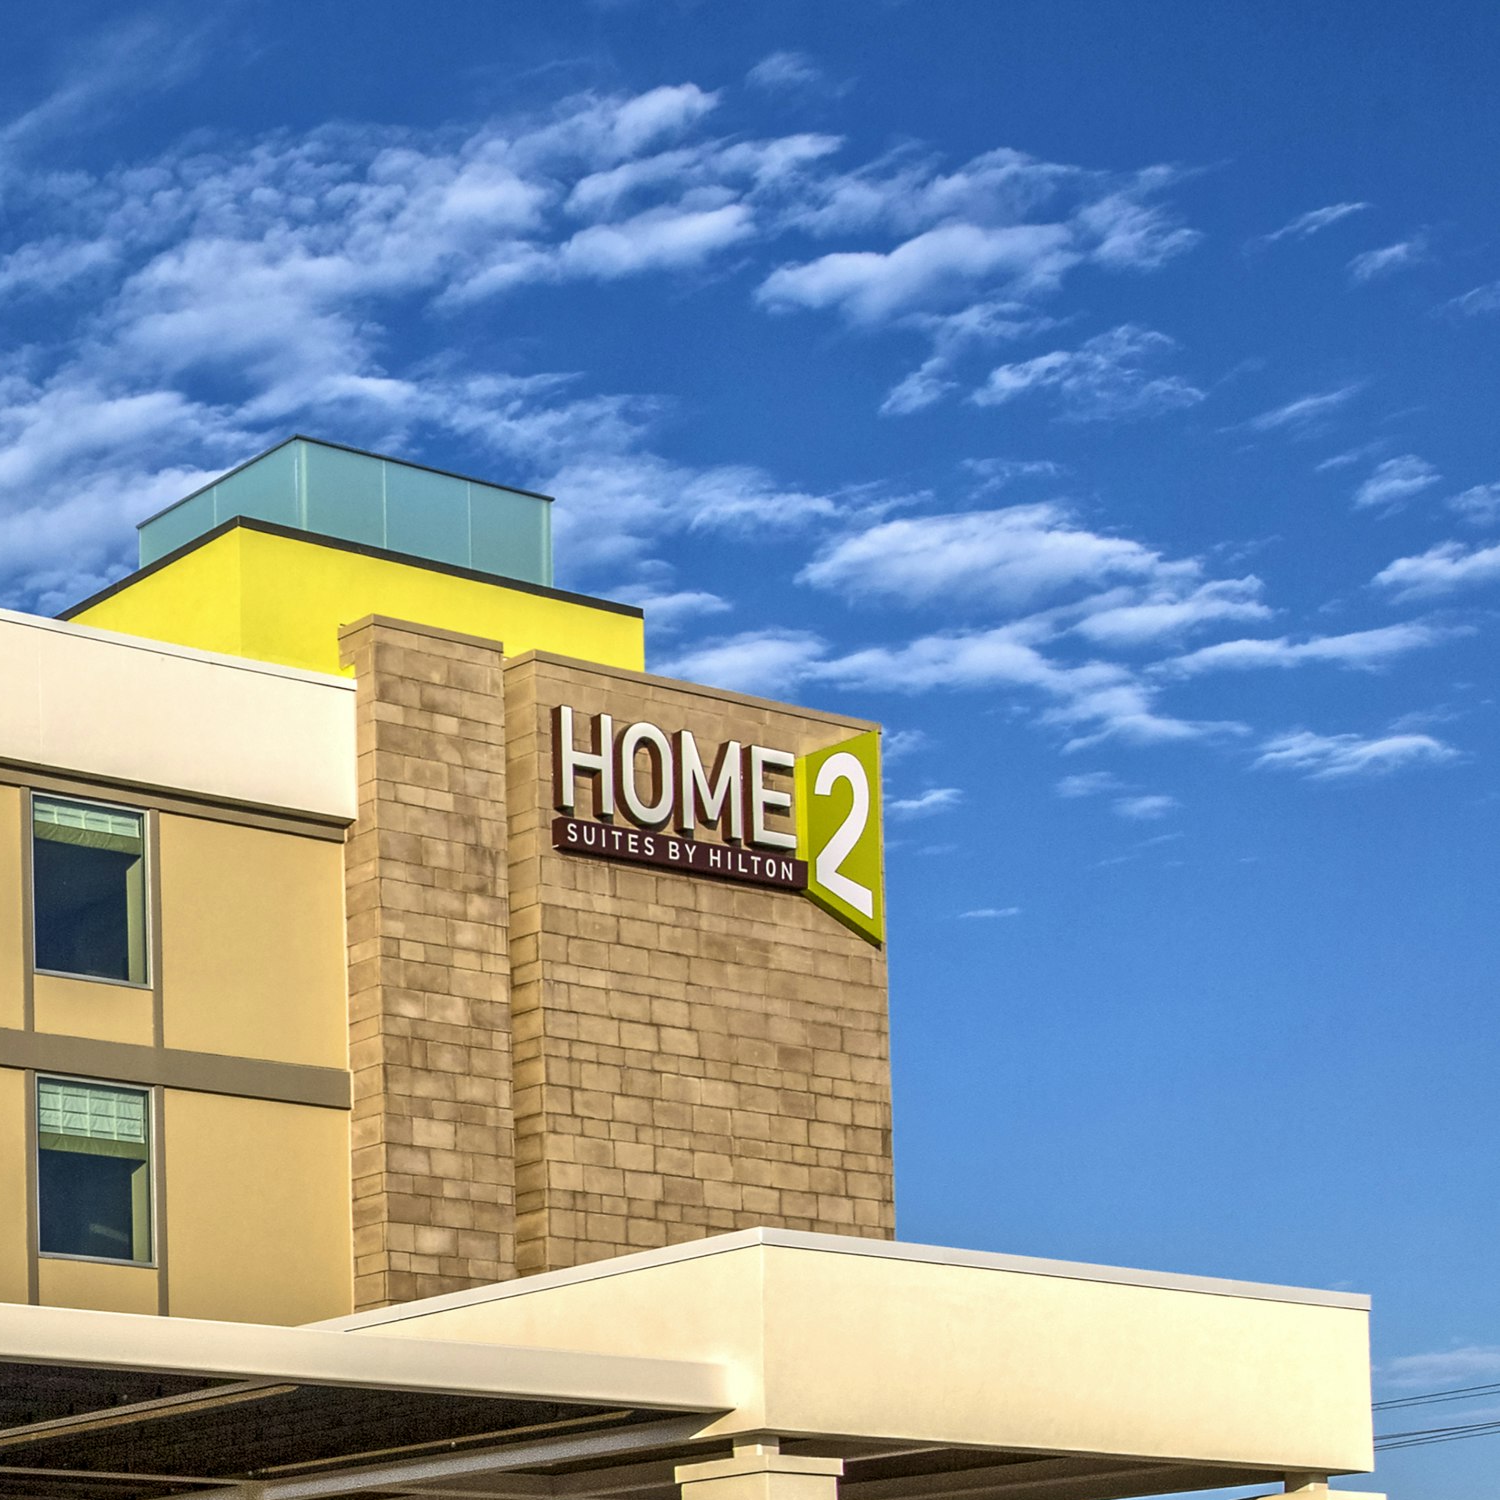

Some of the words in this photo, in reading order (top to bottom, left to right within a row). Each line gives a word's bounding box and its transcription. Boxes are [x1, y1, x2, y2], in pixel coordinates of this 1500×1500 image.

[553, 704, 797, 850] HOME
[814, 751, 873, 919] 2
[567, 823, 655, 856] SUITES
[668, 841, 697, 863] BY
[709, 848, 793, 881] HILTON
